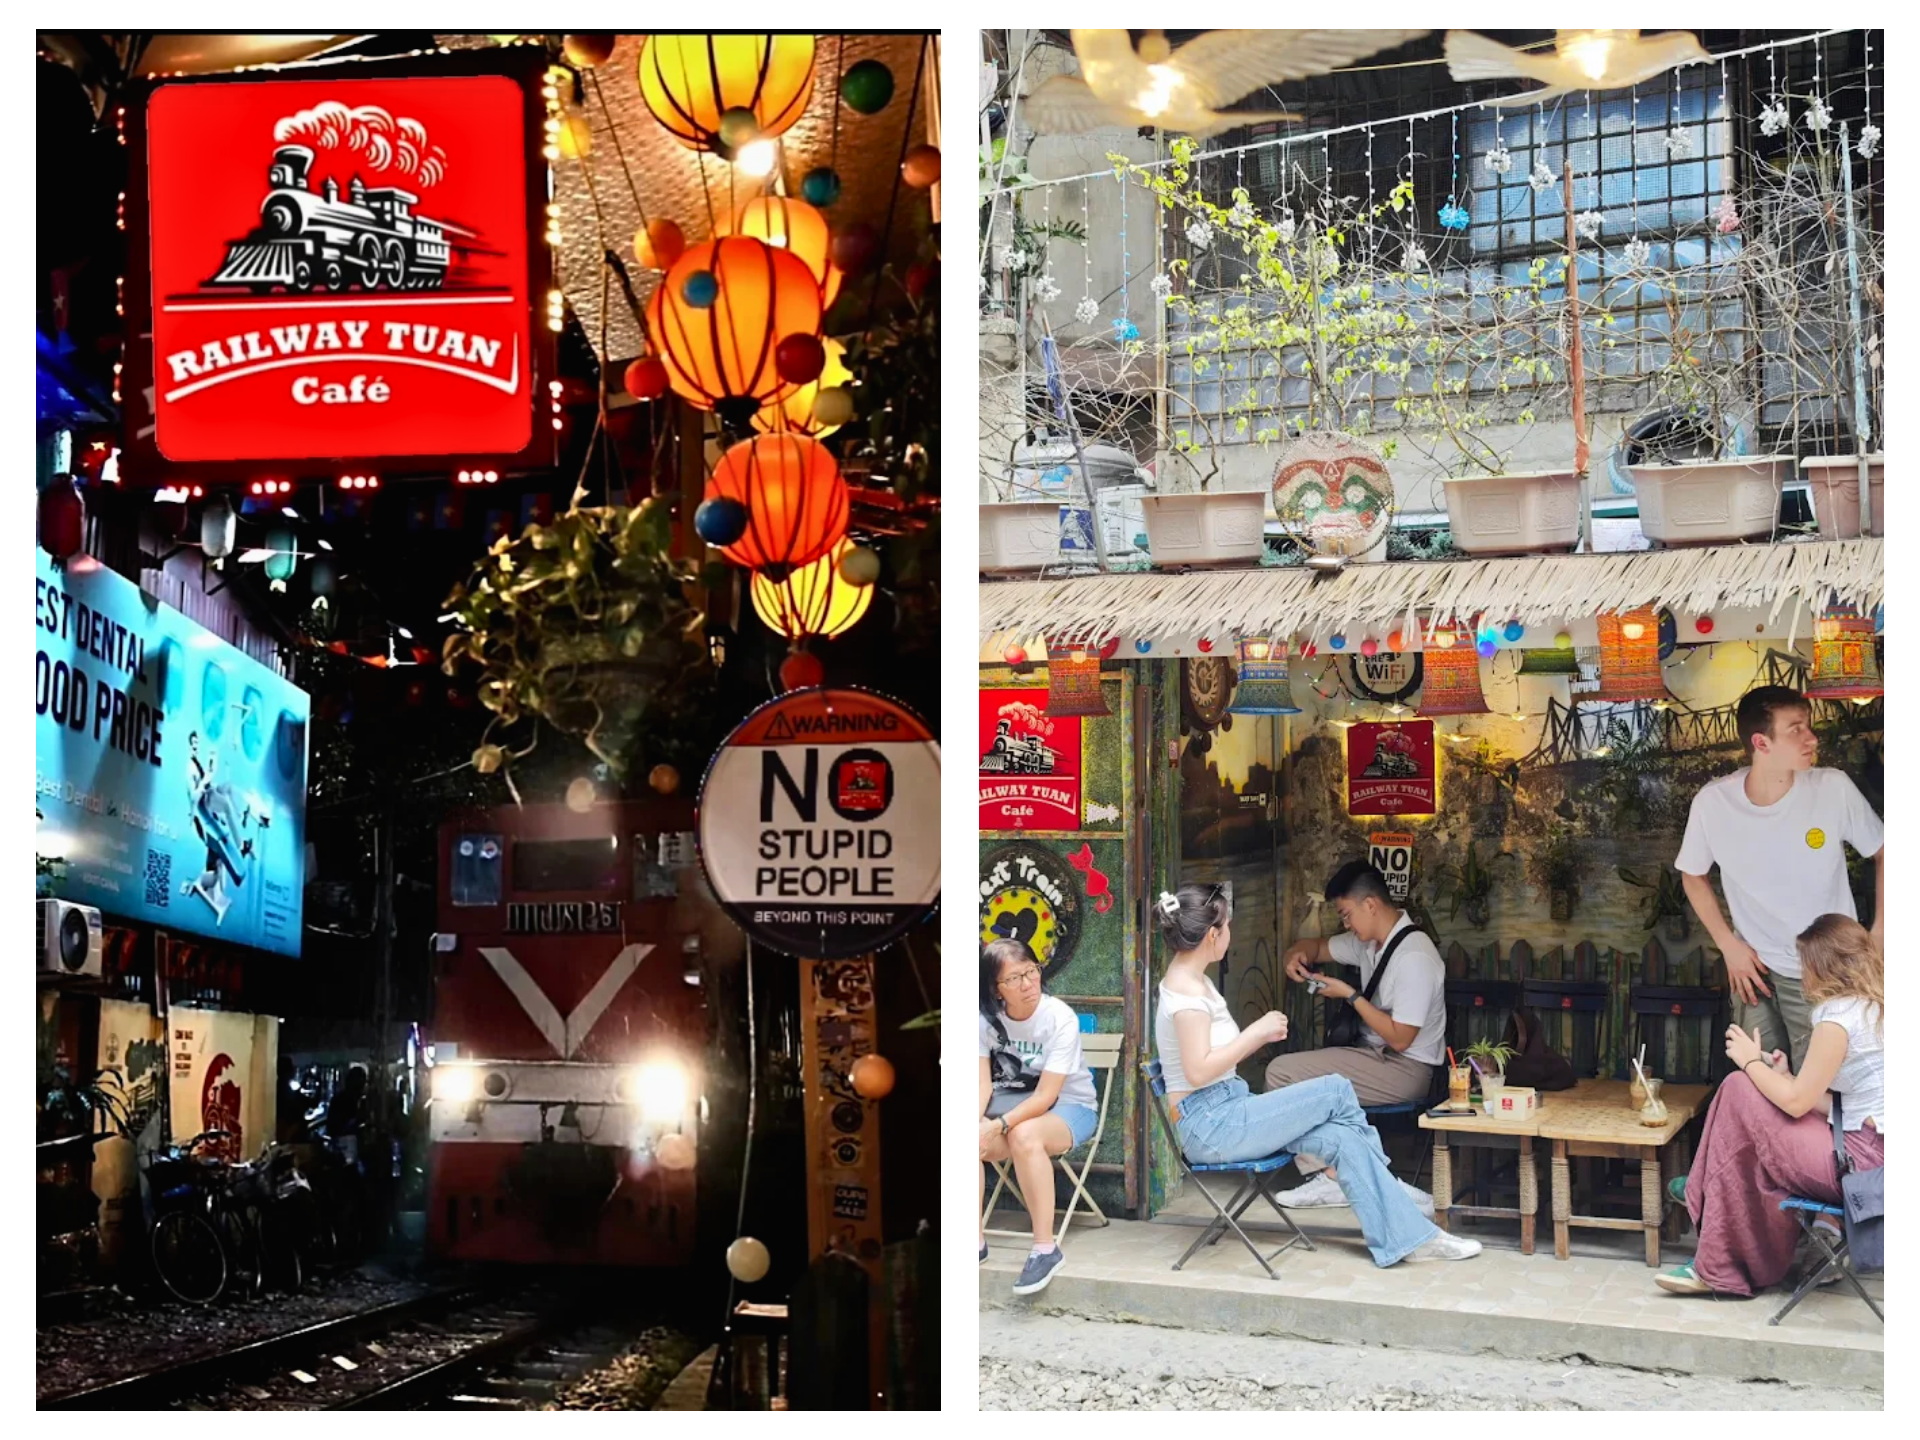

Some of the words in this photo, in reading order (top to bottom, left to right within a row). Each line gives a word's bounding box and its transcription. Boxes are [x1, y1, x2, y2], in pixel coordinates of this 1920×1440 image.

[166, 320, 369, 382] RAILWAY
[384, 322, 501, 367] TUAN
[291, 375, 391, 404] Café
[36, 576, 74, 640] EST
[76, 602, 147, 683] DENTAL
[1365, 664, 1405, 679] WiFi
[36, 650, 88, 732] OOD
[94, 680, 164, 767] PRICE
[793, 713, 898, 733] WARNING
[760, 748, 894, 822] NO
[979, 785, 1027, 801] AILWAY
[1032, 785, 1071, 804] TUAN
[1352, 785, 1398, 799] RAILWAY
[1401, 785, 1428, 796] TUAN
[1001, 804, 1034, 816] Café
[758, 829, 892, 860] STUPID
[1372, 847, 1408, 872] NO
[756, 866, 894, 897] PEOPLE
[1388, 885, 1407, 894] PLE
[754, 911, 812, 923] BEYOND
[815, 911, 847, 924] THIS
[850, 911, 895, 924] POINT
